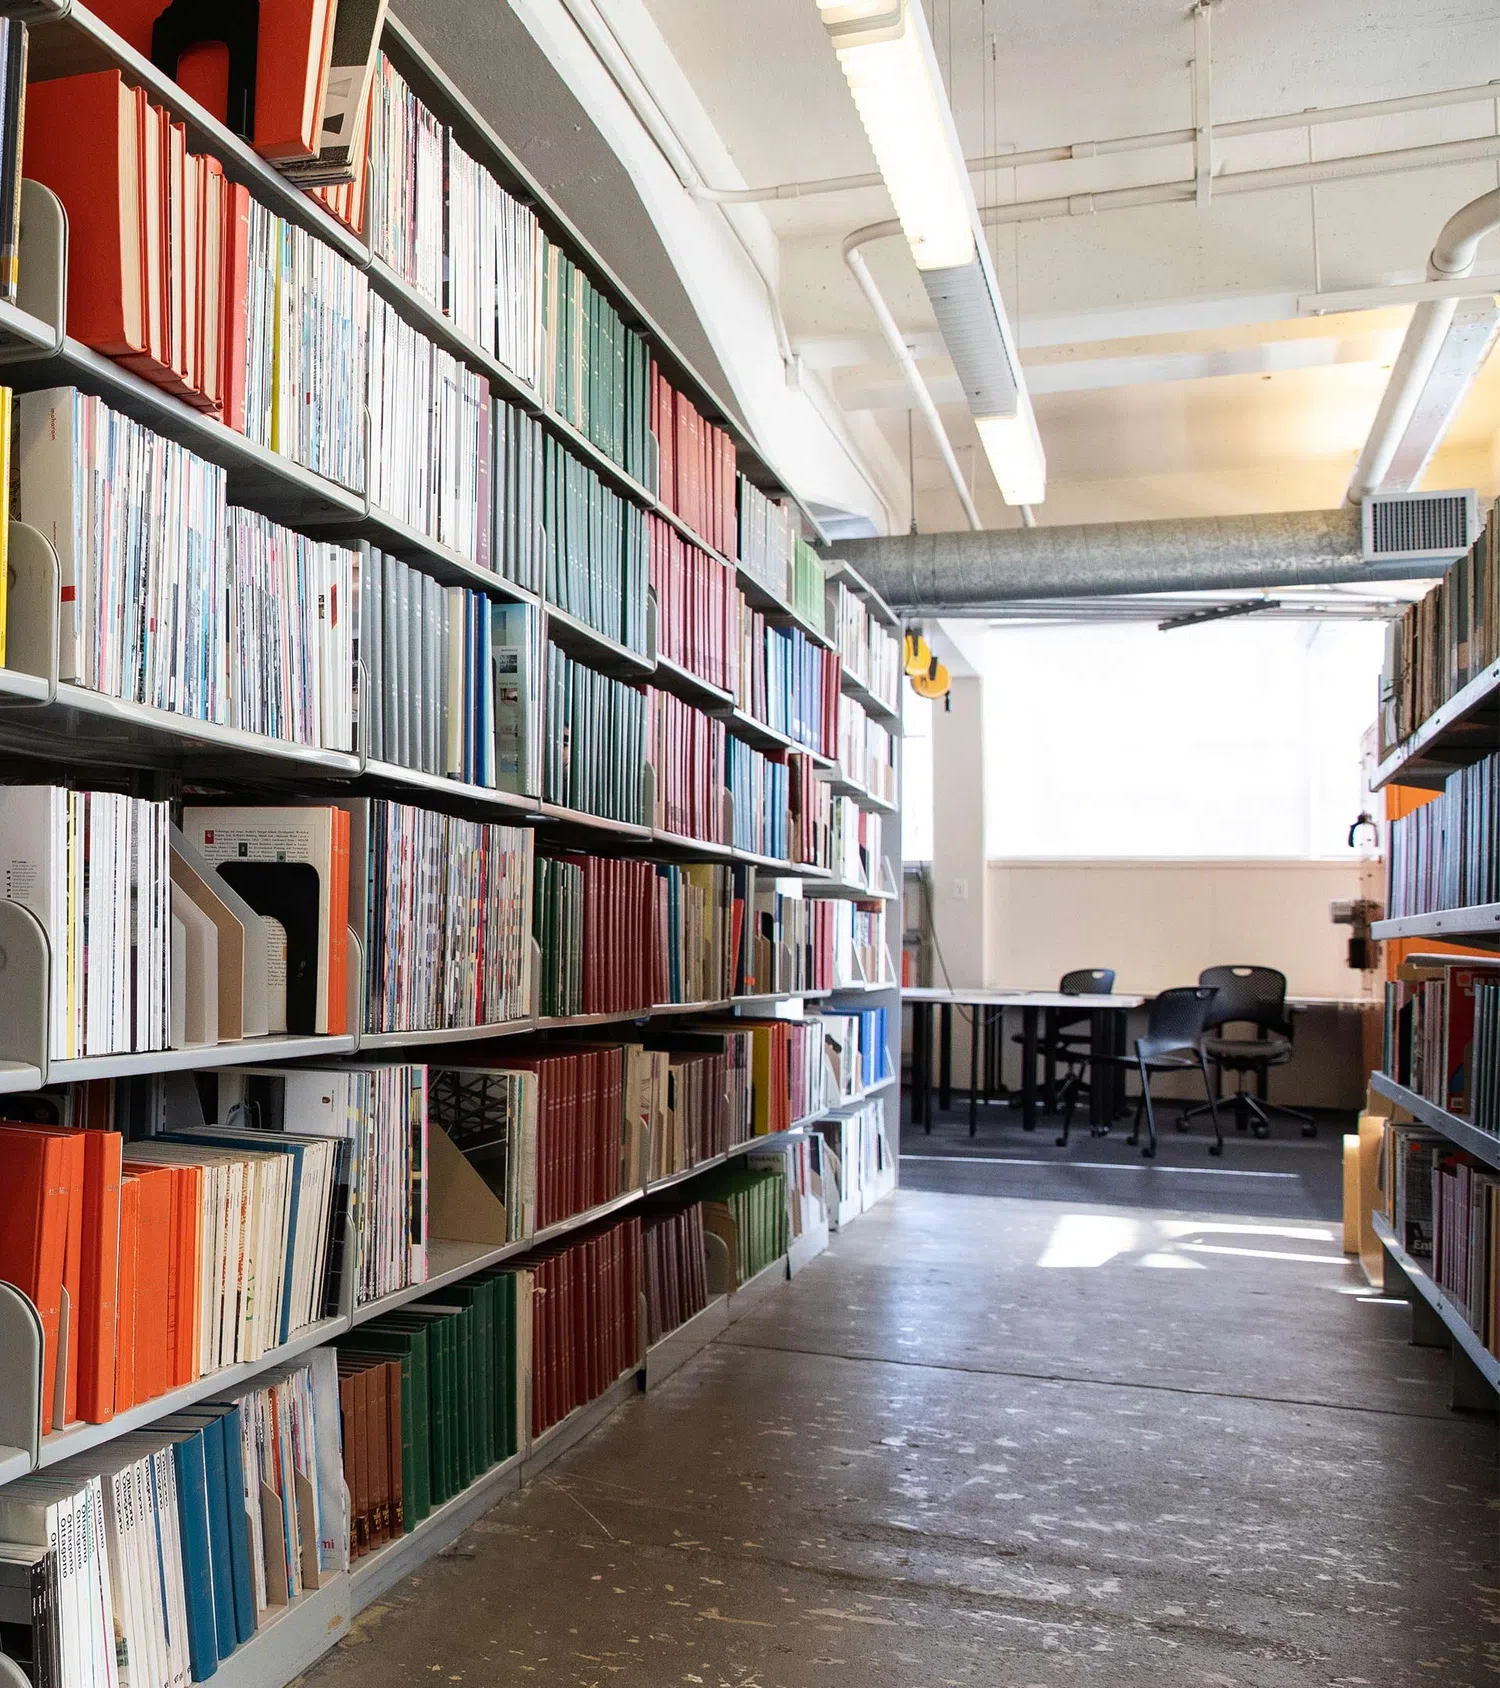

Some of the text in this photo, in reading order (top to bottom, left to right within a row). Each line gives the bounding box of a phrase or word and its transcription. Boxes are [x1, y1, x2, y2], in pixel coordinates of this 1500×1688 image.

[114, 1479, 124, 1535] Ottagono
[122, 1475, 131, 1531] Ottagono
[125, 1471, 135, 1527] Ottagono
[135, 1466, 144, 1522] Ottagono
[144, 1459, 153, 1513] Ottagono
[155, 1456, 165, 1510] Ottagono
[75, 1509, 83, 1570] Ottagono
[96, 1489, 105, 1549] Ottagono
[60, 1517, 69, 1579] Ottagono
